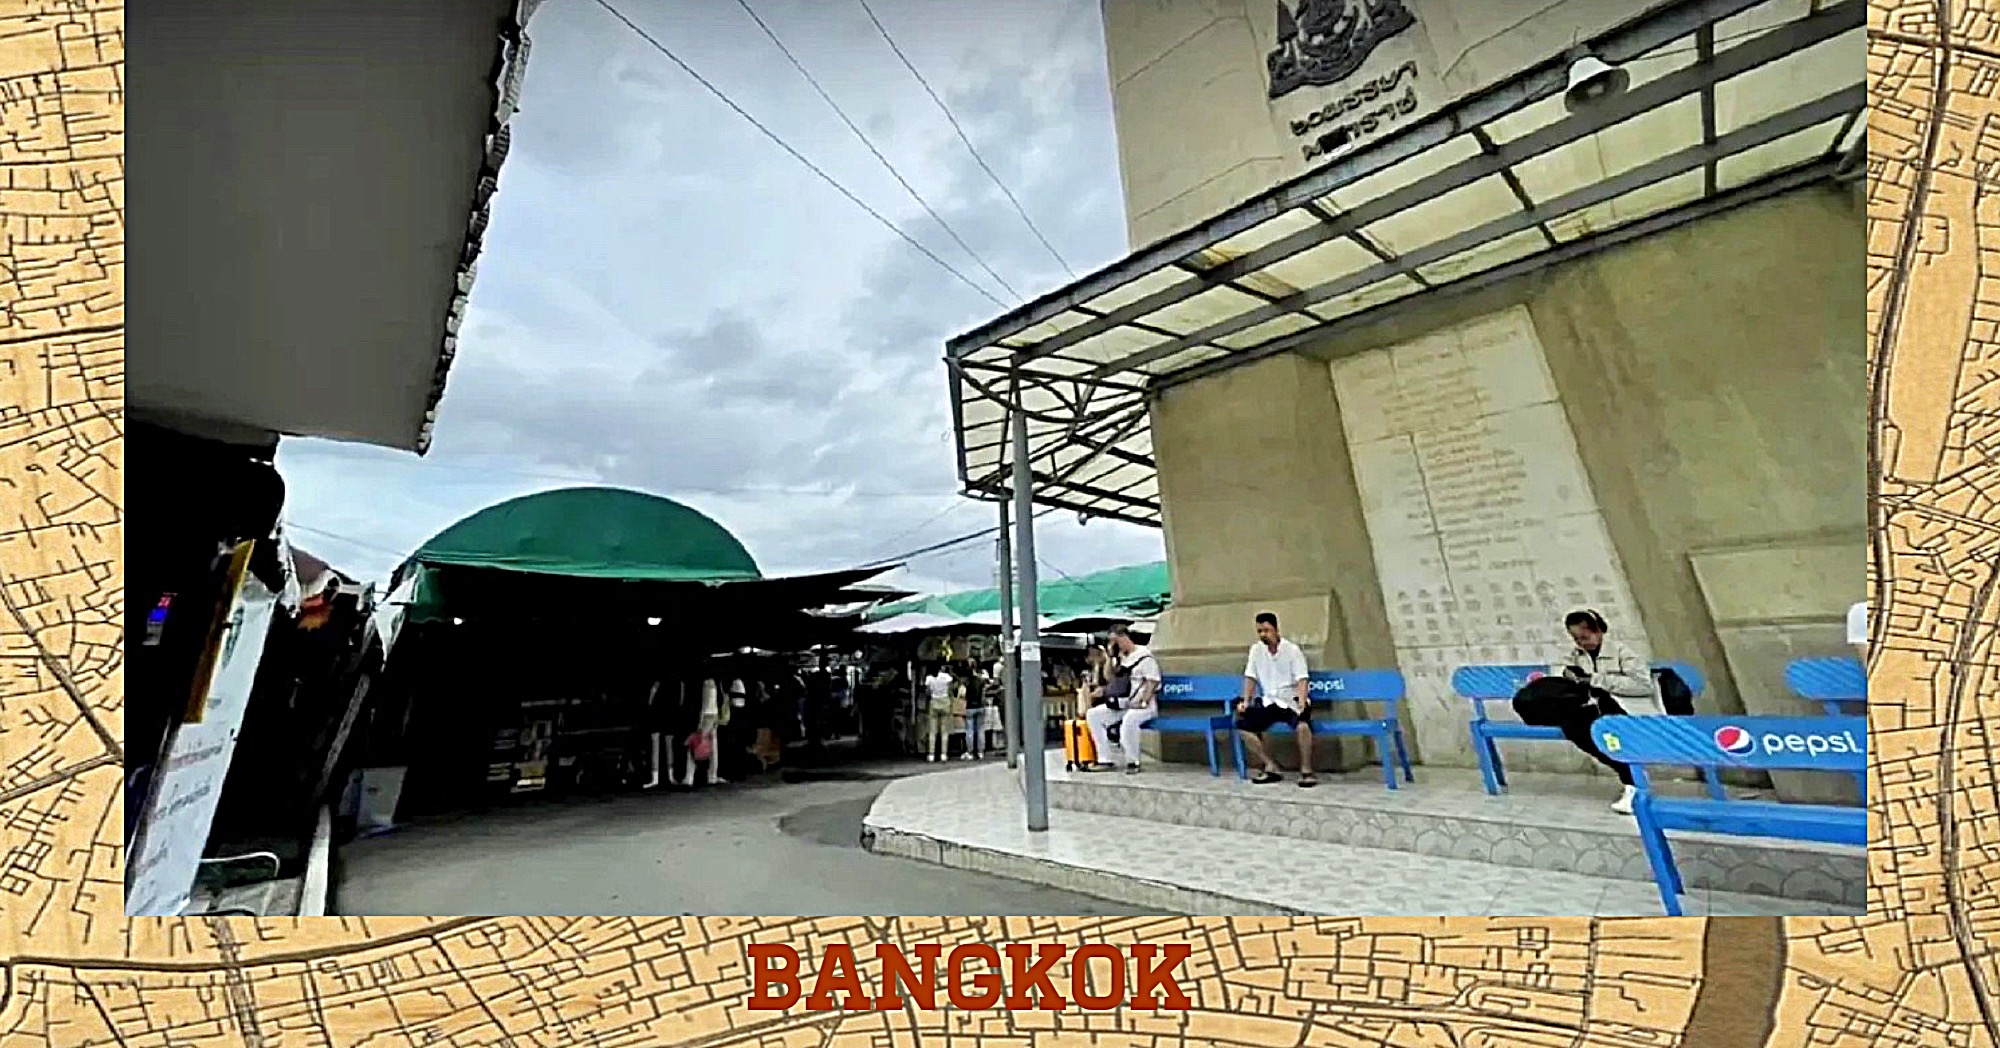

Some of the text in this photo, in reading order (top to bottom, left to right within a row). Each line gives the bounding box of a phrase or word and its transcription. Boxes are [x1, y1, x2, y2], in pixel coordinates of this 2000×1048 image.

[1302, 86, 1418, 161] มาราช
[1164, 682, 1194, 696] pepsi
[1308, 677, 1346, 693] pepsi
[1763, 730, 1857, 757] pepsi
